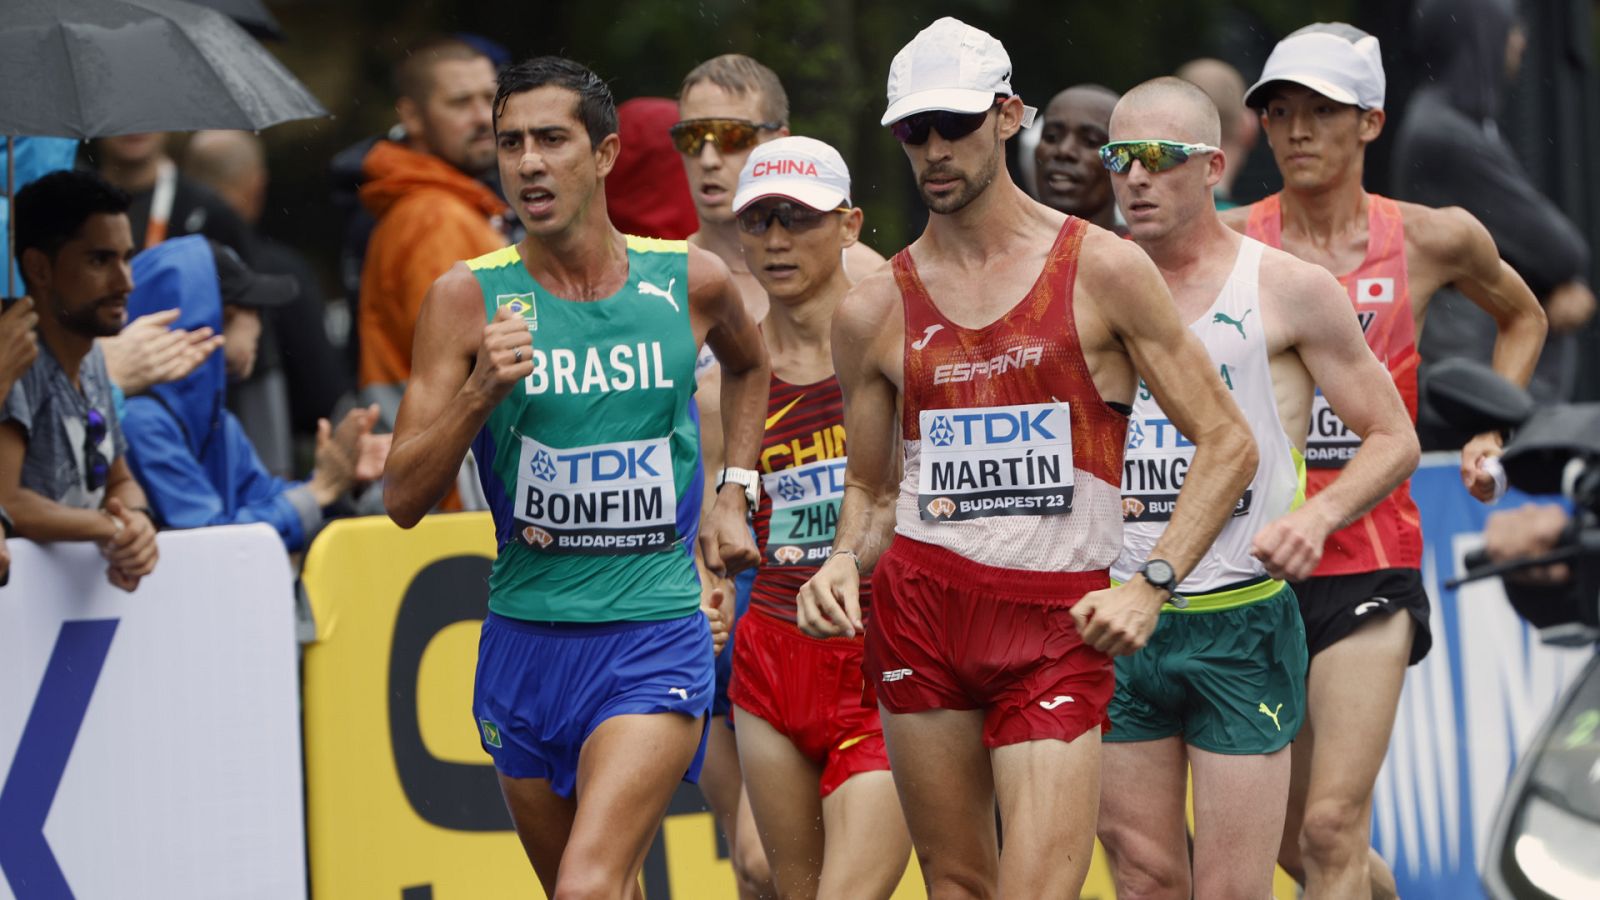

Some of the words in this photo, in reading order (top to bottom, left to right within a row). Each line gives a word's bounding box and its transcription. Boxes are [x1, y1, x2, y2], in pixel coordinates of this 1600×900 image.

[752, 159, 818, 177] CHINA
[524, 341, 674, 395] BRASIL
[933, 345, 1045, 386] ESPAÑA
[953, 408, 1057, 446] TDK
[556, 444, 661, 485] TDK
[930, 448, 1062, 491] MARTÍN
[524, 484, 663, 524] BONFIM
[959, 495, 1044, 513] BUDAPEST
[1046, 494, 1065, 507] 23
[558, 534, 646, 548] BUDAPEST
[647, 531, 666, 545] 23
[882, 668, 914, 682] ESP
